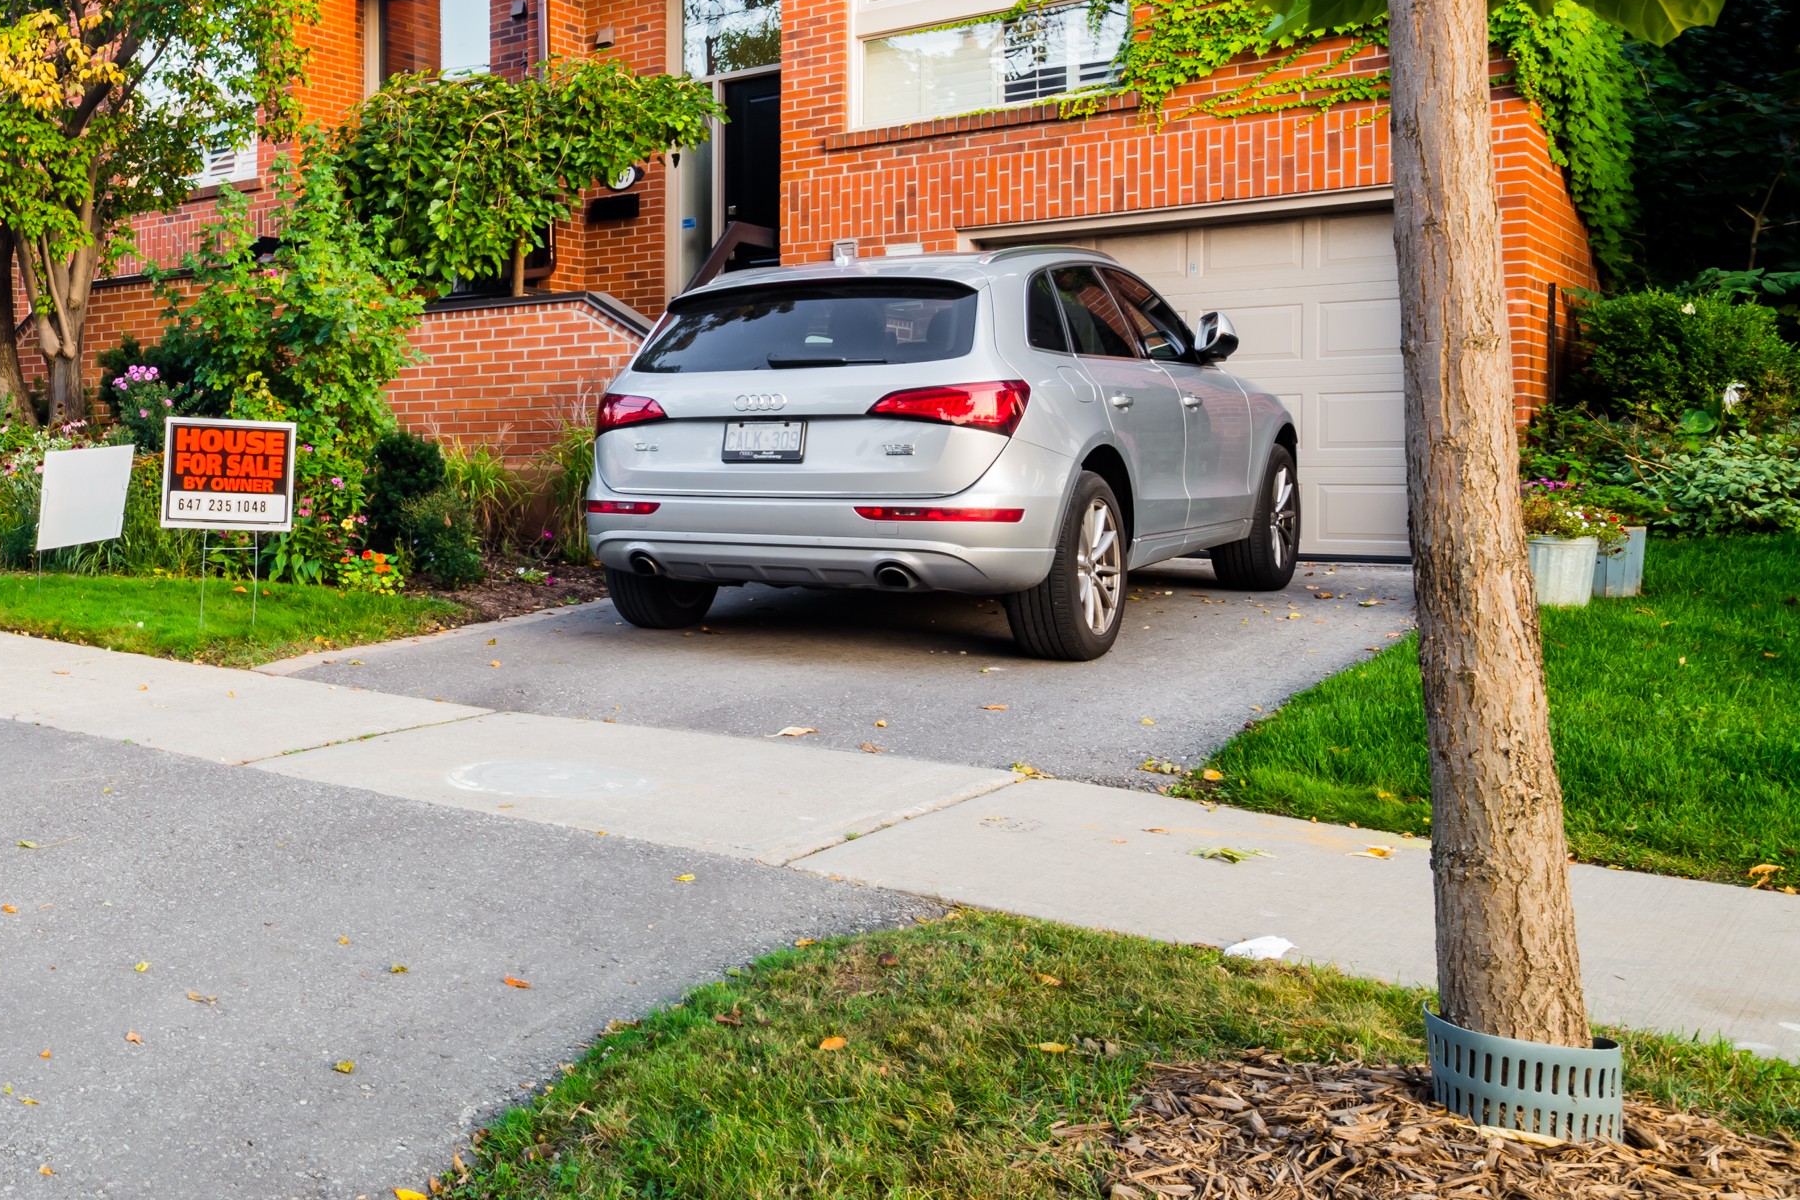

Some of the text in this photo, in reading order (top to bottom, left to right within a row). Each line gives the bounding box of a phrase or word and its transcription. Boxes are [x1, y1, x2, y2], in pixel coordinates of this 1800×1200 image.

[176, 427, 286, 456] HOUSE
[728, 431, 799, 450] CALK 309
[176, 452, 283, 479] FOR SALE
[183, 476, 274, 493] BY OWNER
[178, 498, 267, 513] 647 235 1048
